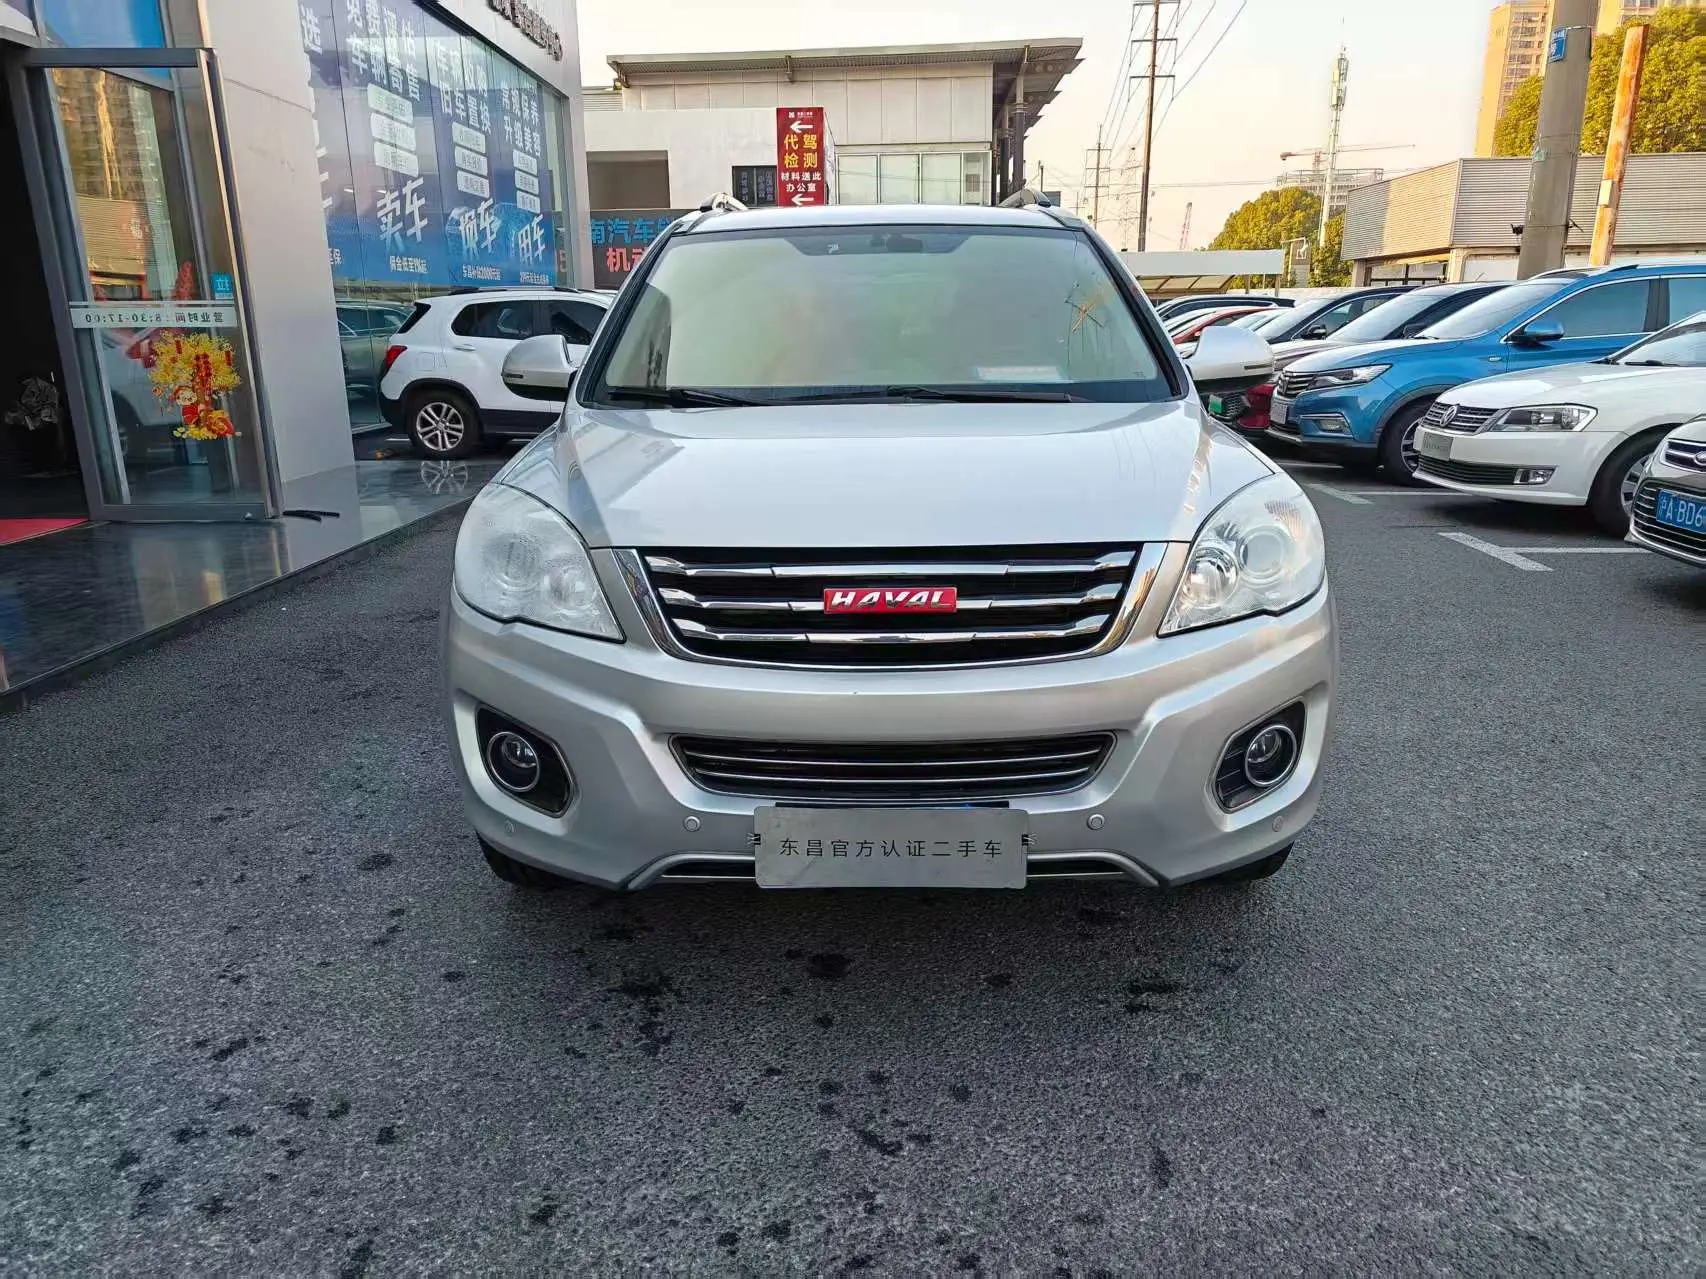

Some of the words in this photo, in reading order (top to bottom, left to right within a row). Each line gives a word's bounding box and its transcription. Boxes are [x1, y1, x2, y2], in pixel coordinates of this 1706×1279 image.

[784, 134, 818, 150] 代驾
[784, 152, 818, 168] 检测
[786, 183, 817, 192] 办公室
[376, 177, 428, 252] 卖车
[831, 590, 950, 608] HAVAL
[779, 838, 1003, 859] 东昌官方认证二手车
